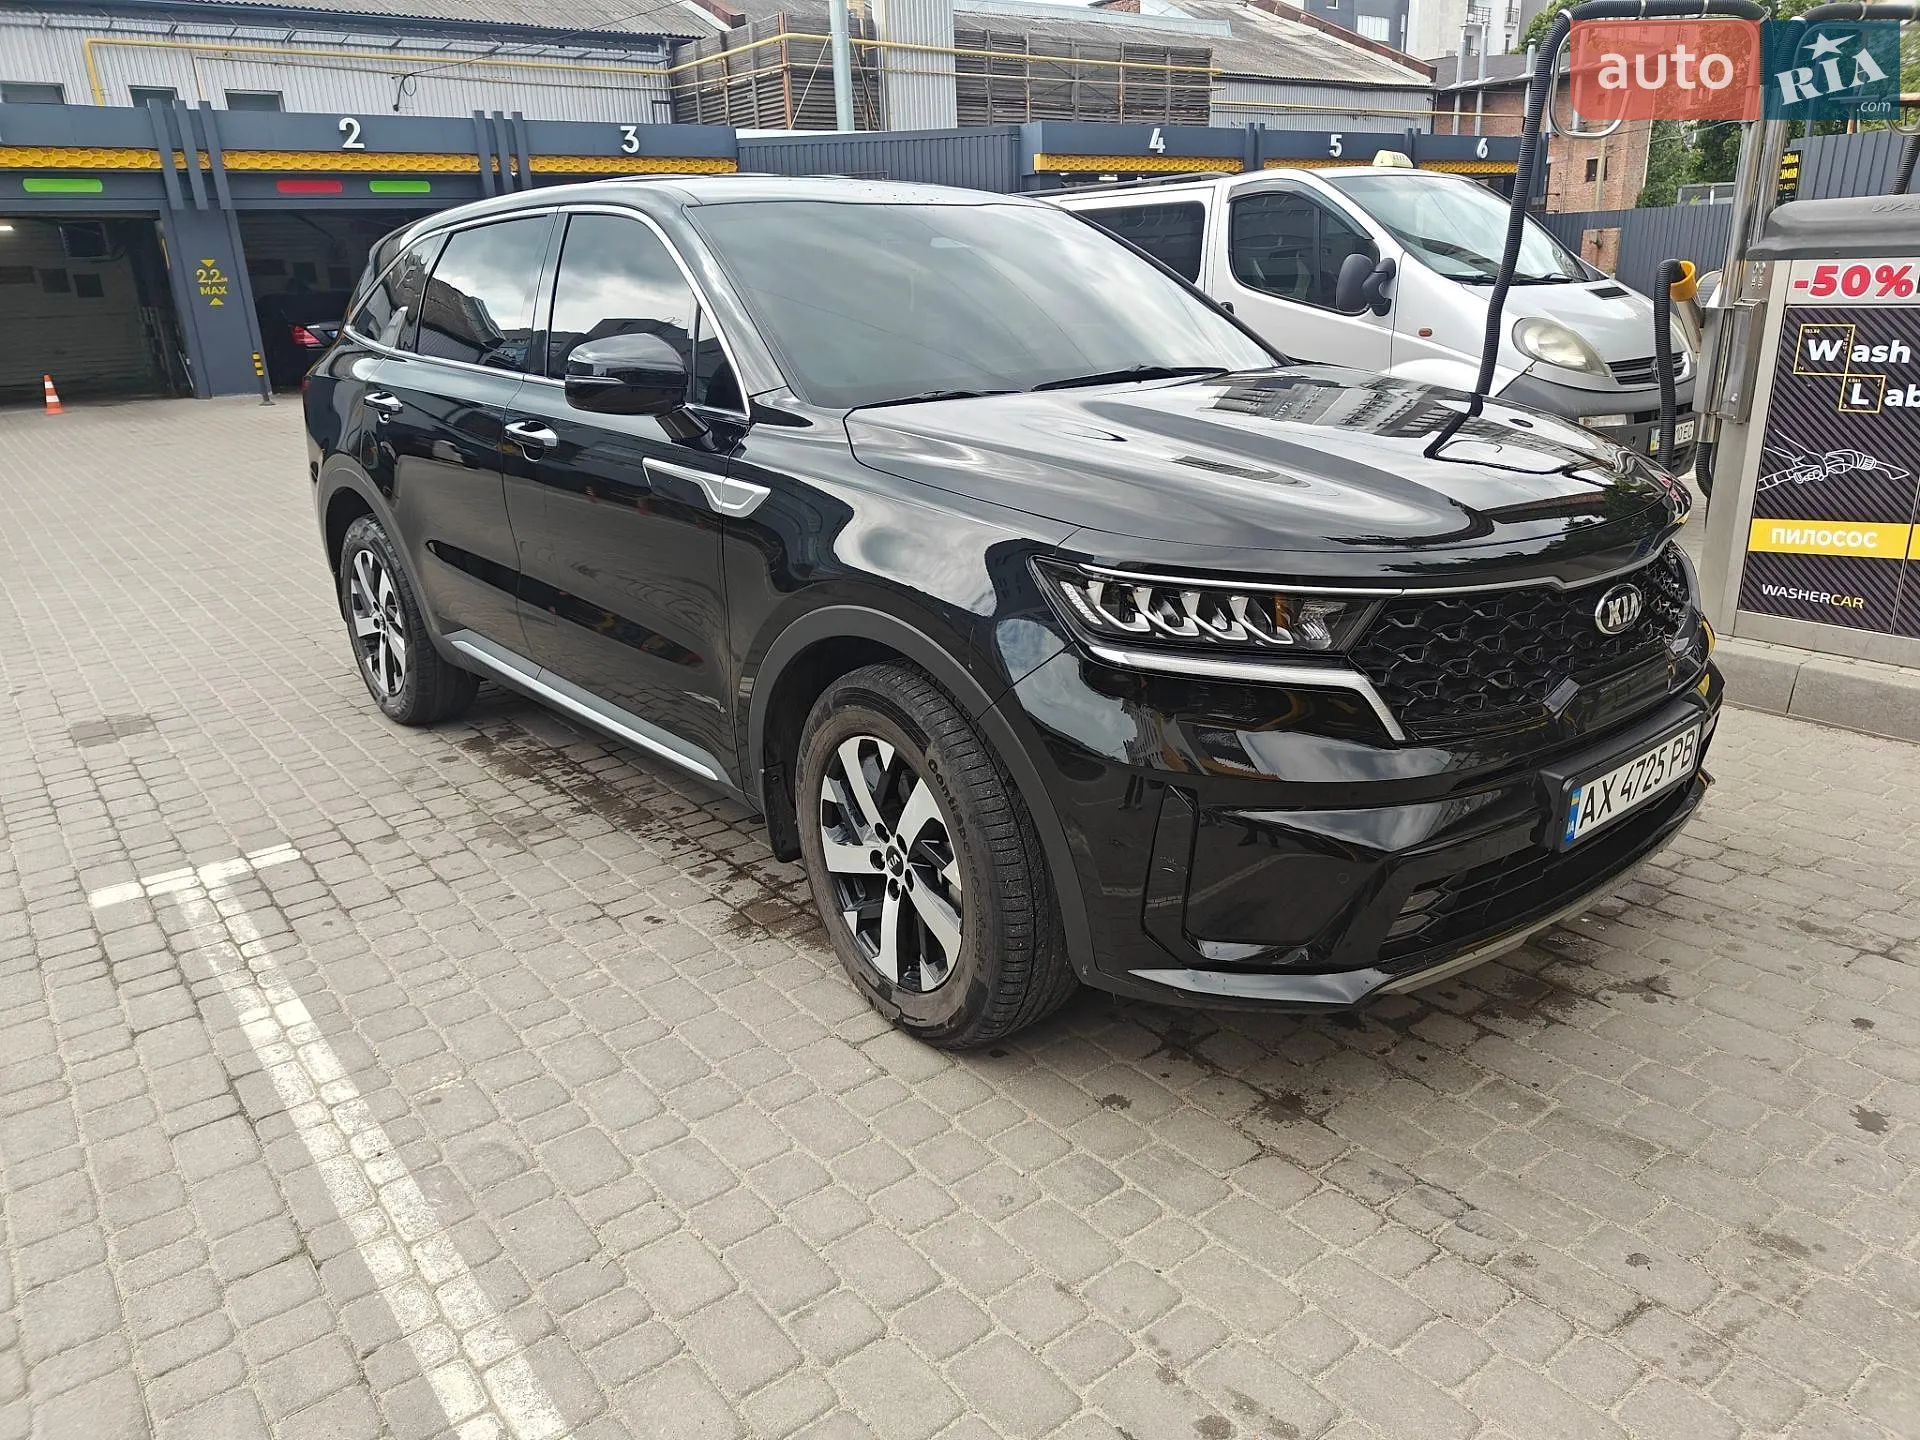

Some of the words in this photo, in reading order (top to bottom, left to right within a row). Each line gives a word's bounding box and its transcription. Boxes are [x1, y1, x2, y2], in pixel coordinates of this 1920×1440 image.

[338, 117, 365, 149] 2
[620, 125, 640, 153] 3
[1149, 127, 1166, 154] 4
[1328, 134, 1343, 158] 5
[1476, 137, 1489, 159] 6
[1794, 264, 1914, 297] -50%
[1771, 527, 1878, 548] ПИЛОСОС
[1606, 592, 1640, 628] KIA
[1762, 584, 1864, 609] WASHERCAR
[1578, 773, 1617, 829] AX
[1620, 746, 1665, 803] 4725
[1669, 729, 1696, 778] PB
